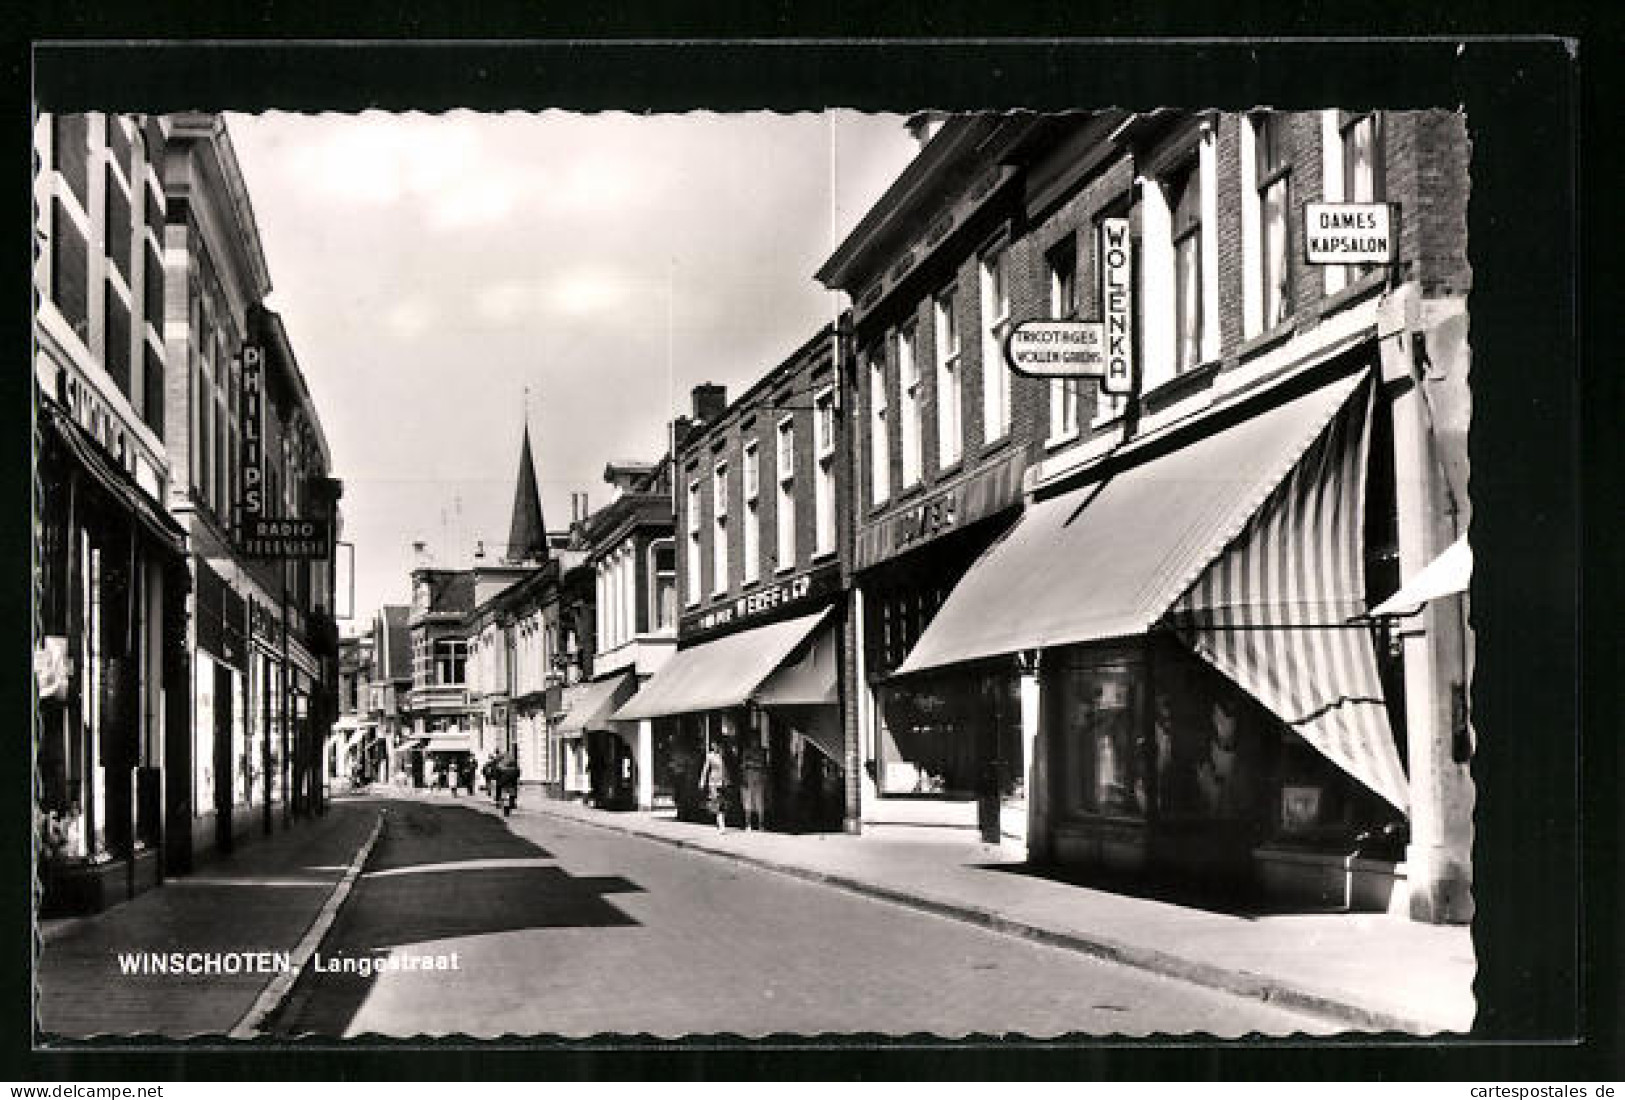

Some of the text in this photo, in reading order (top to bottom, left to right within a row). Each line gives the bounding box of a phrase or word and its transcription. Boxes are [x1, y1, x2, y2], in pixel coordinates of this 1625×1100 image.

[1318, 211, 1377, 229] DAMES
[1310, 236, 1388, 253] KAPSALON
[1106, 225, 1127, 379] WOLENKA
[243, 346, 261, 513] PHILIPS
[256, 522, 314, 537] RADIO
